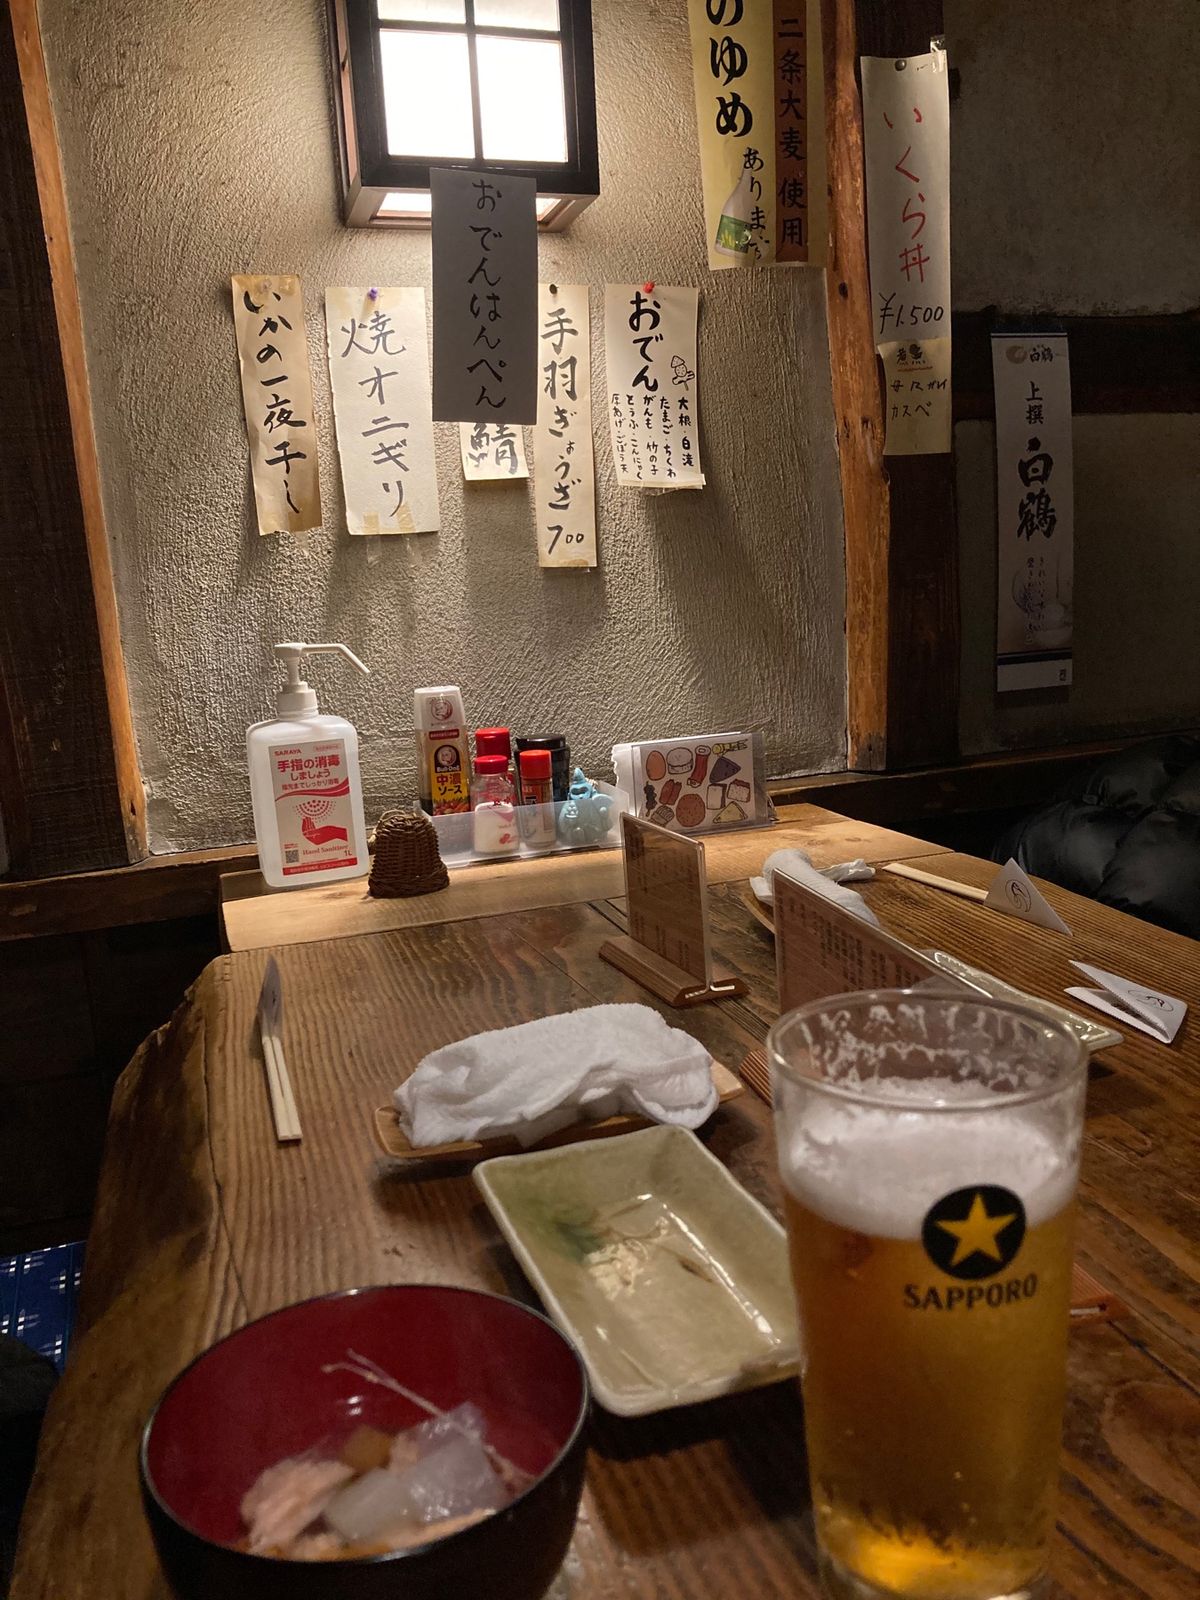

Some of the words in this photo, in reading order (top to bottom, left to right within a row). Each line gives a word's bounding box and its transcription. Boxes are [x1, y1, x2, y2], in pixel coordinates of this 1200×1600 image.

[777, 18, 808, 247] 二条大麦使用
[883, 107, 931, 284] いくら丼
[467, 178, 507, 409] おでんはんぺん
[628, 290, 664, 392] おでん
[243, 290, 306, 514] いかの一夜干し
[340, 308, 410, 518] 焼オニギリ
[541, 306, 582, 511] 手羽ぎょうざ
[1025, 381, 1045, 425] 上撰
[546, 524, 585, 556] 700
[1017, 436, 1057, 542] 白鶴
[277, 754, 341, 773] 手指の消毒
[290, 769, 331, 782] しましょう
[436, 772, 461, 786] 中濃
[438, 785, 463, 796] ソース
[903, 1271, 1039, 1312] SAPPORO
